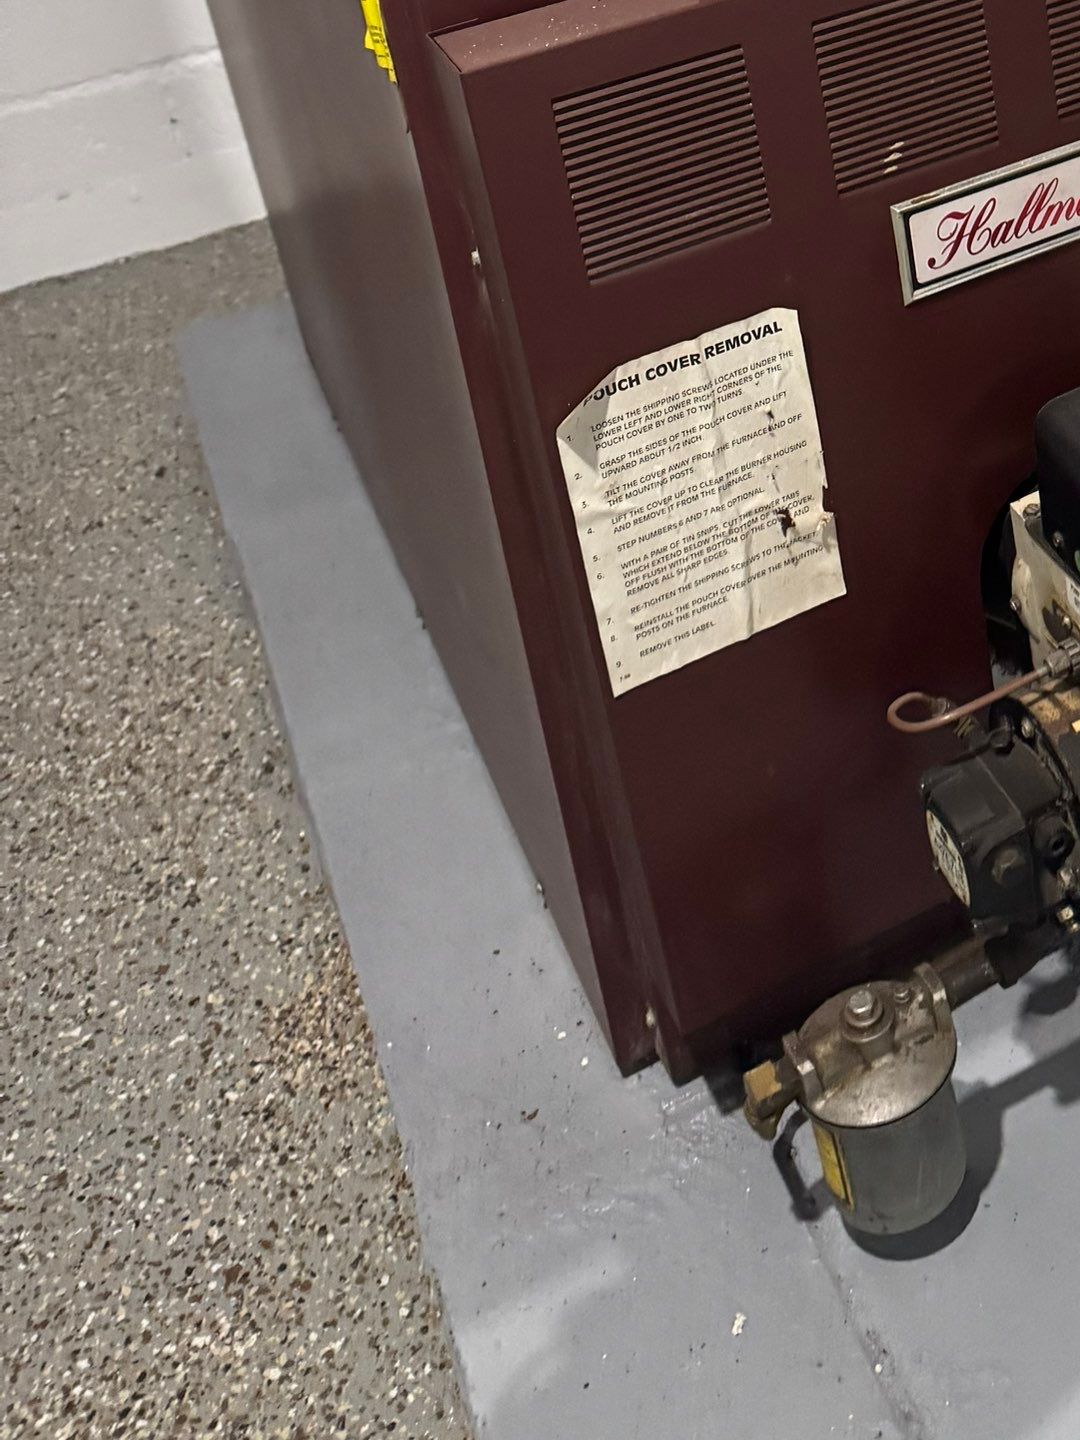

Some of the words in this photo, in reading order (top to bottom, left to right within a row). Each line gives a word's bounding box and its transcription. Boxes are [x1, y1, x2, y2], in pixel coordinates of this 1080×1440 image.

[645, 353, 700, 380] COVER
[704, 322, 782, 359] REMOVAL
[589, 415, 623, 434] LOOSEN
[625, 407, 641, 418] THE
[642, 392, 680, 412] SHIPPING
[681, 379, 713, 397] SCREWS
[714, 366, 748, 385] LOCATED
[749, 355, 777, 371] UNDER
[778, 350, 793, 360] THE
[591, 425, 622, 443] LOWER
[623, 416, 643, 430] LEFT
[644, 410, 663, 422] AND
[663, 398, 691, 415] LOWER
[693, 389, 715, 403] RIGHT
[716, 374, 753, 394] CORNERS
[754, 369, 765, 379] OF
[765, 363, 782, 374] THE
[574, 472, 582, 480] 2.
[599, 454, 626, 469] GRASP
[627, 447, 644, 458] THE
[645, 437, 667, 452] SIDES
[668, 432, 680, 442] OF
[681, 426, 696, 437] THE
[698, 415, 725, 431] POUCH
[726, 404, 752, 419] COVER
[754, 397, 771, 409] AND
[772, 390, 786, 402] LIFT
[593, 434, 624, 452] POUCH
[626, 423, 653, 439] COVER
[654, 418, 665, 428] BY
[667, 411, 684, 423] ONE
[685, 406, 697, 416] TO
[601, 460, 637, 479] UPWARD
[639, 448, 665, 464] ABOUT
[667, 442, 680, 452] 1/2
[605, 486, 620, 498] TILT
[622, 479, 638, 491] THE
[639, 468, 666, 483] COVER
[668, 457, 690, 472] AWAY
[691, 450, 716, 463] FROM
[716, 442, 729, 454] THE
[731, 427, 769, 446] FURNACE
[787, 413, 802, 424] OFF
[586, 527, 595, 535] 4.
[611, 512, 627, 525] LIFT
[629, 506, 644, 517] THE
[646, 495, 672, 511] COVER
[674, 489, 686, 499] UP
[687, 484, 698, 493] TO
[699, 475, 724, 489] CLEAR
[725, 467, 739, 479] THE
[740, 454, 772, 472] BURNER
[773, 440, 807, 458] HOUSING
[613, 521, 631, 534] AND
[632, 508, 666, 526] REMOVE
[676, 493, 699, 508] FROM
[699, 487, 716, 498] THE
[617, 538, 637, 552] STEP
[638, 523, 677, 543] NUMBERS
[678, 519, 684, 527] 6
[685, 512, 702, 524] AND
[703, 508, 708, 517] 7
[710, 503, 726, 514] ARE
